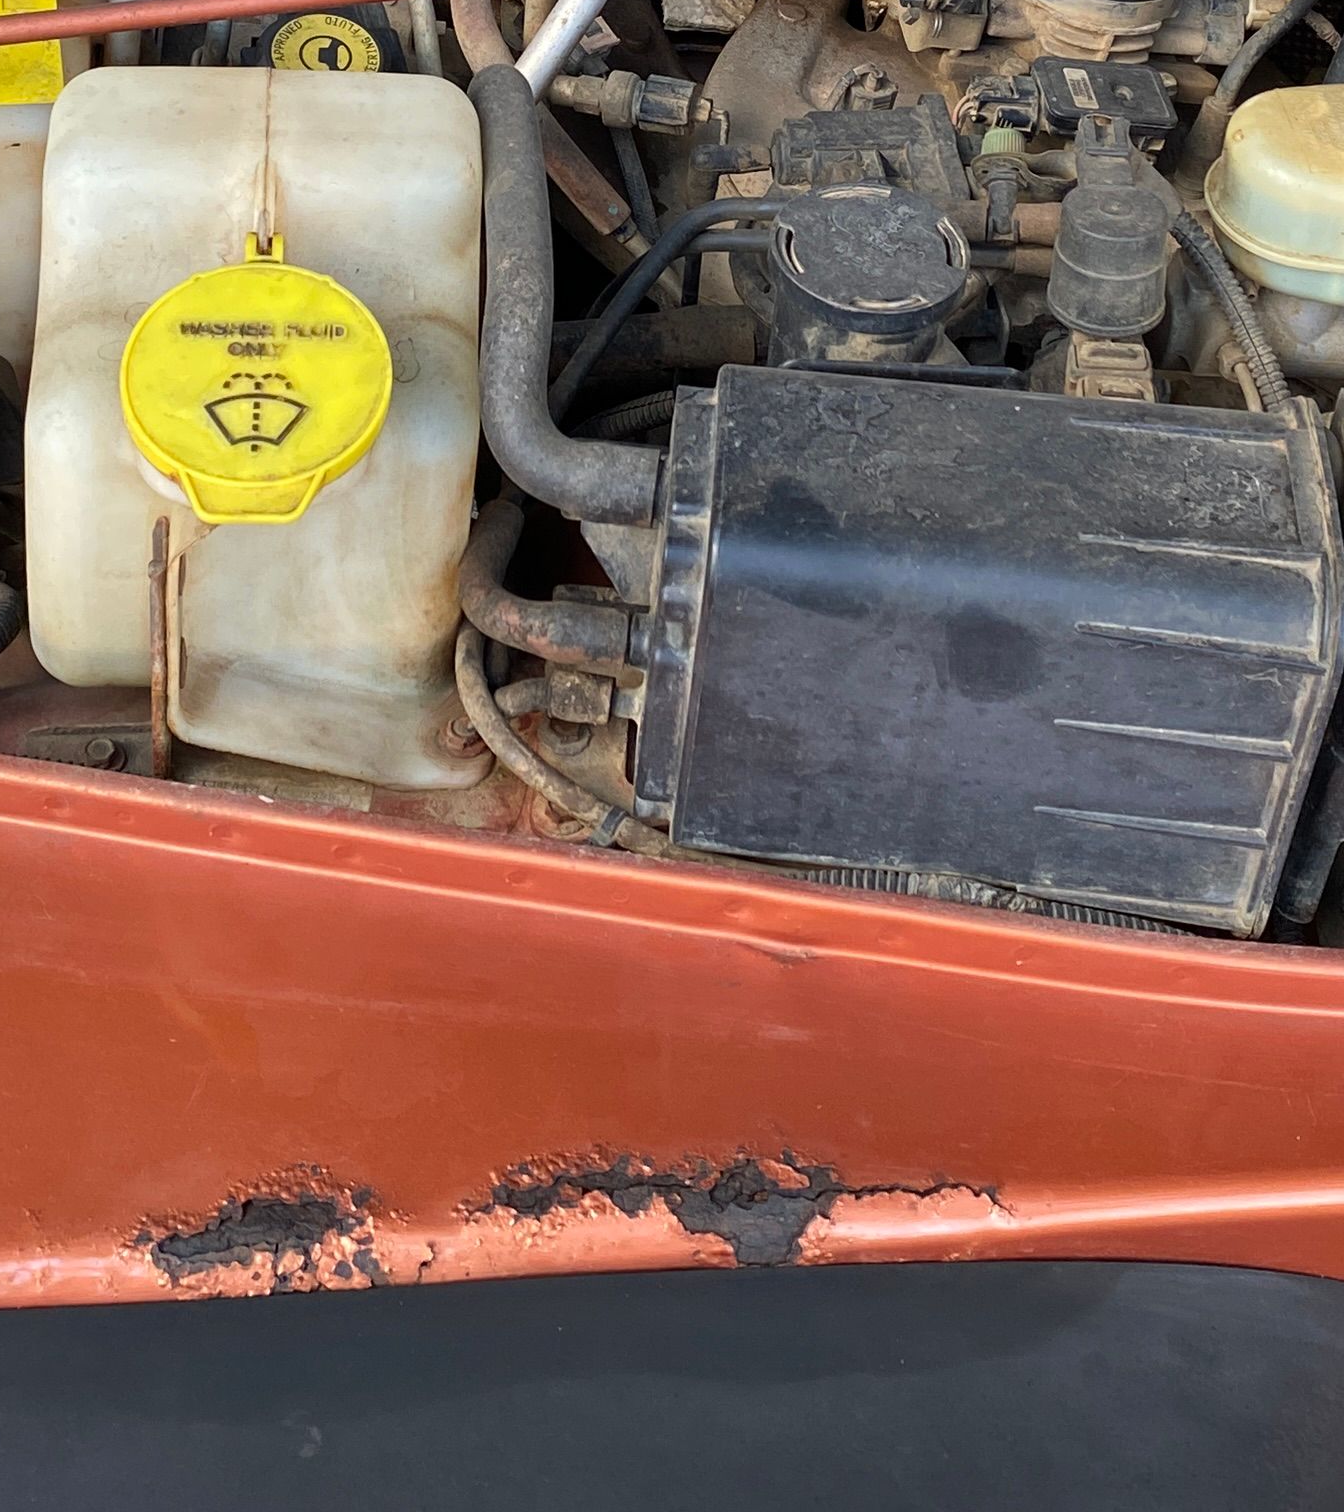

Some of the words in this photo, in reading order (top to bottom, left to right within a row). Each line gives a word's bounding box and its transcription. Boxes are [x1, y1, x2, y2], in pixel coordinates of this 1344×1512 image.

[324, 16, 360, 36] FLUID
[274, 20, 303, 62] APPROVED
[179, 321, 275, 338] WASHER
[284, 322, 347, 338] FLUID
[227, 341, 288, 360] ONLY
